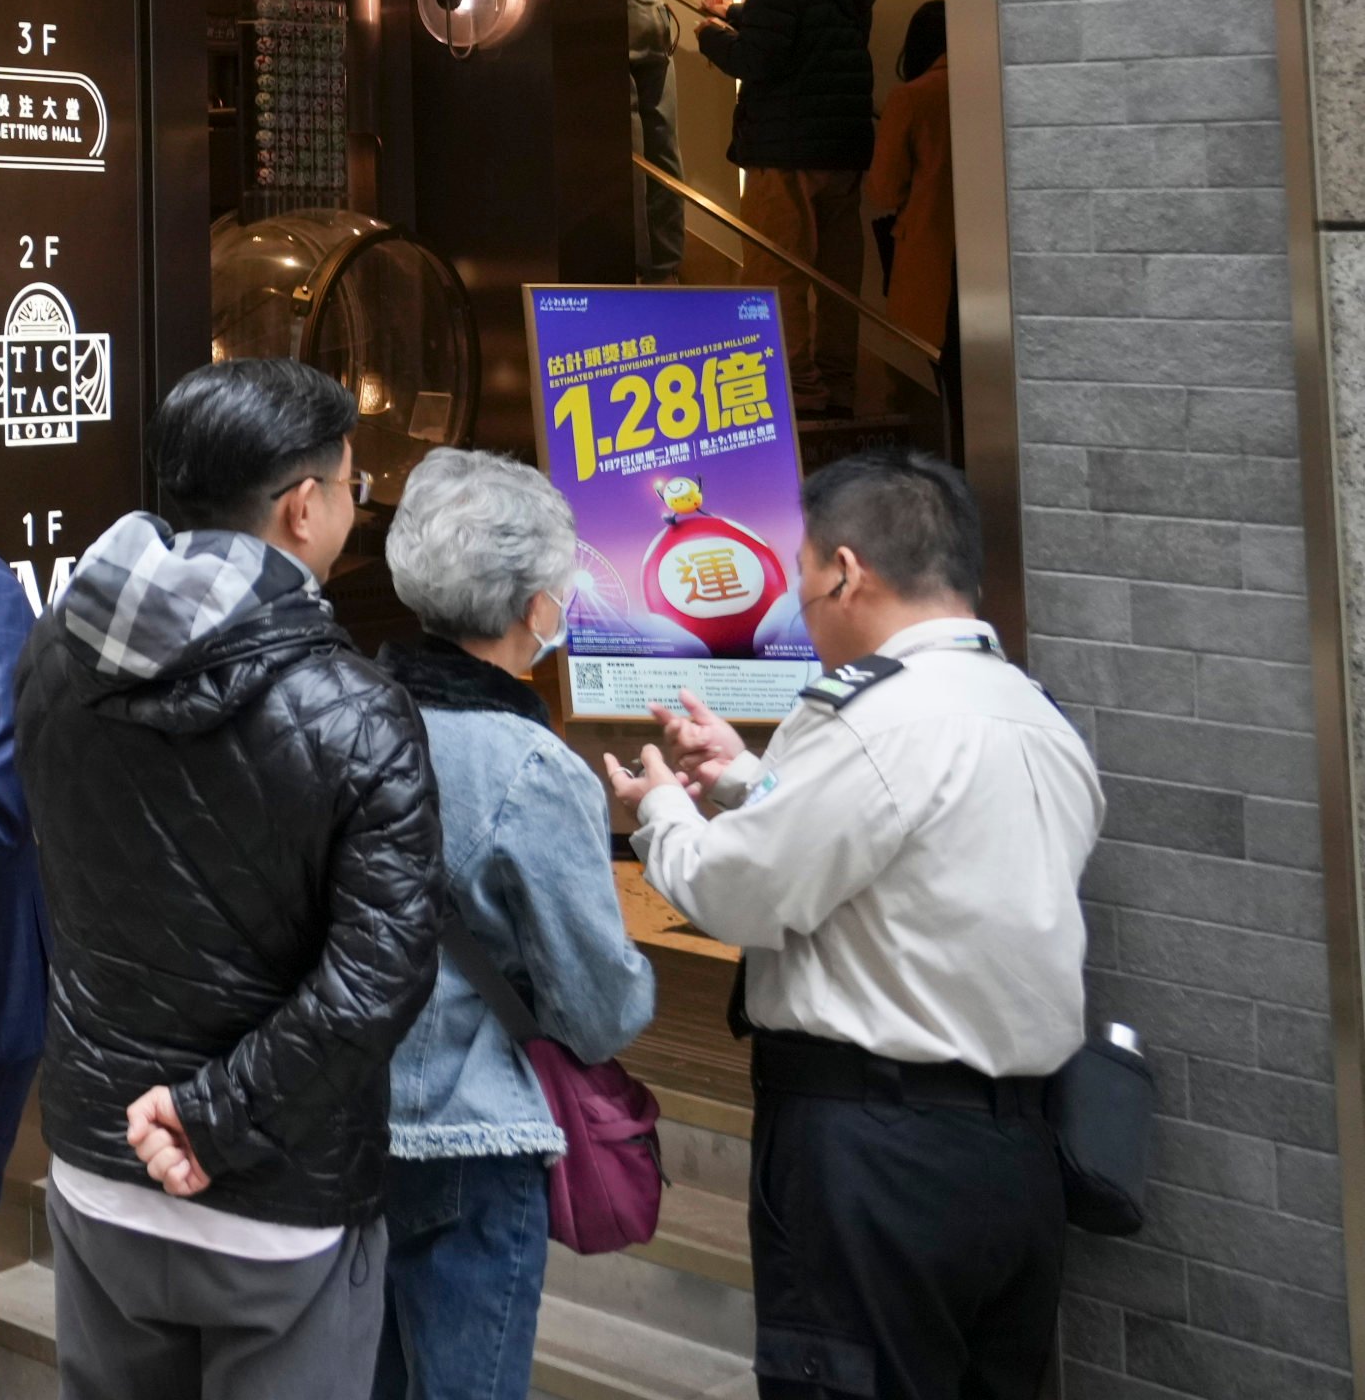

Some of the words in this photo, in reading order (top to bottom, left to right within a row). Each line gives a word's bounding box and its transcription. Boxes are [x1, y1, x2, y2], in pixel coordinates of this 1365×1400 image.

[51, 125, 82, 143] HALL
[10, 345, 69, 373] TIC
[549, 371, 594, 388] ESTIMATED
[595, 366, 618, 381] FIRST
[619, 359, 654, 374] DIVISION
[655, 354, 679, 368] PRIZE
[680, 348, 702, 361] FUND
[11, 385, 69, 415] TAC
[11, 422, 70, 439] ROOM
[701, 446, 720, 457] TICKET
[720, 443, 737, 454] SALES
[622, 464, 641, 476] DRAW
[642, 462, 653, 472] ON
[658, 458, 672, 468] JAN
[675, 547, 750, 604] 運
